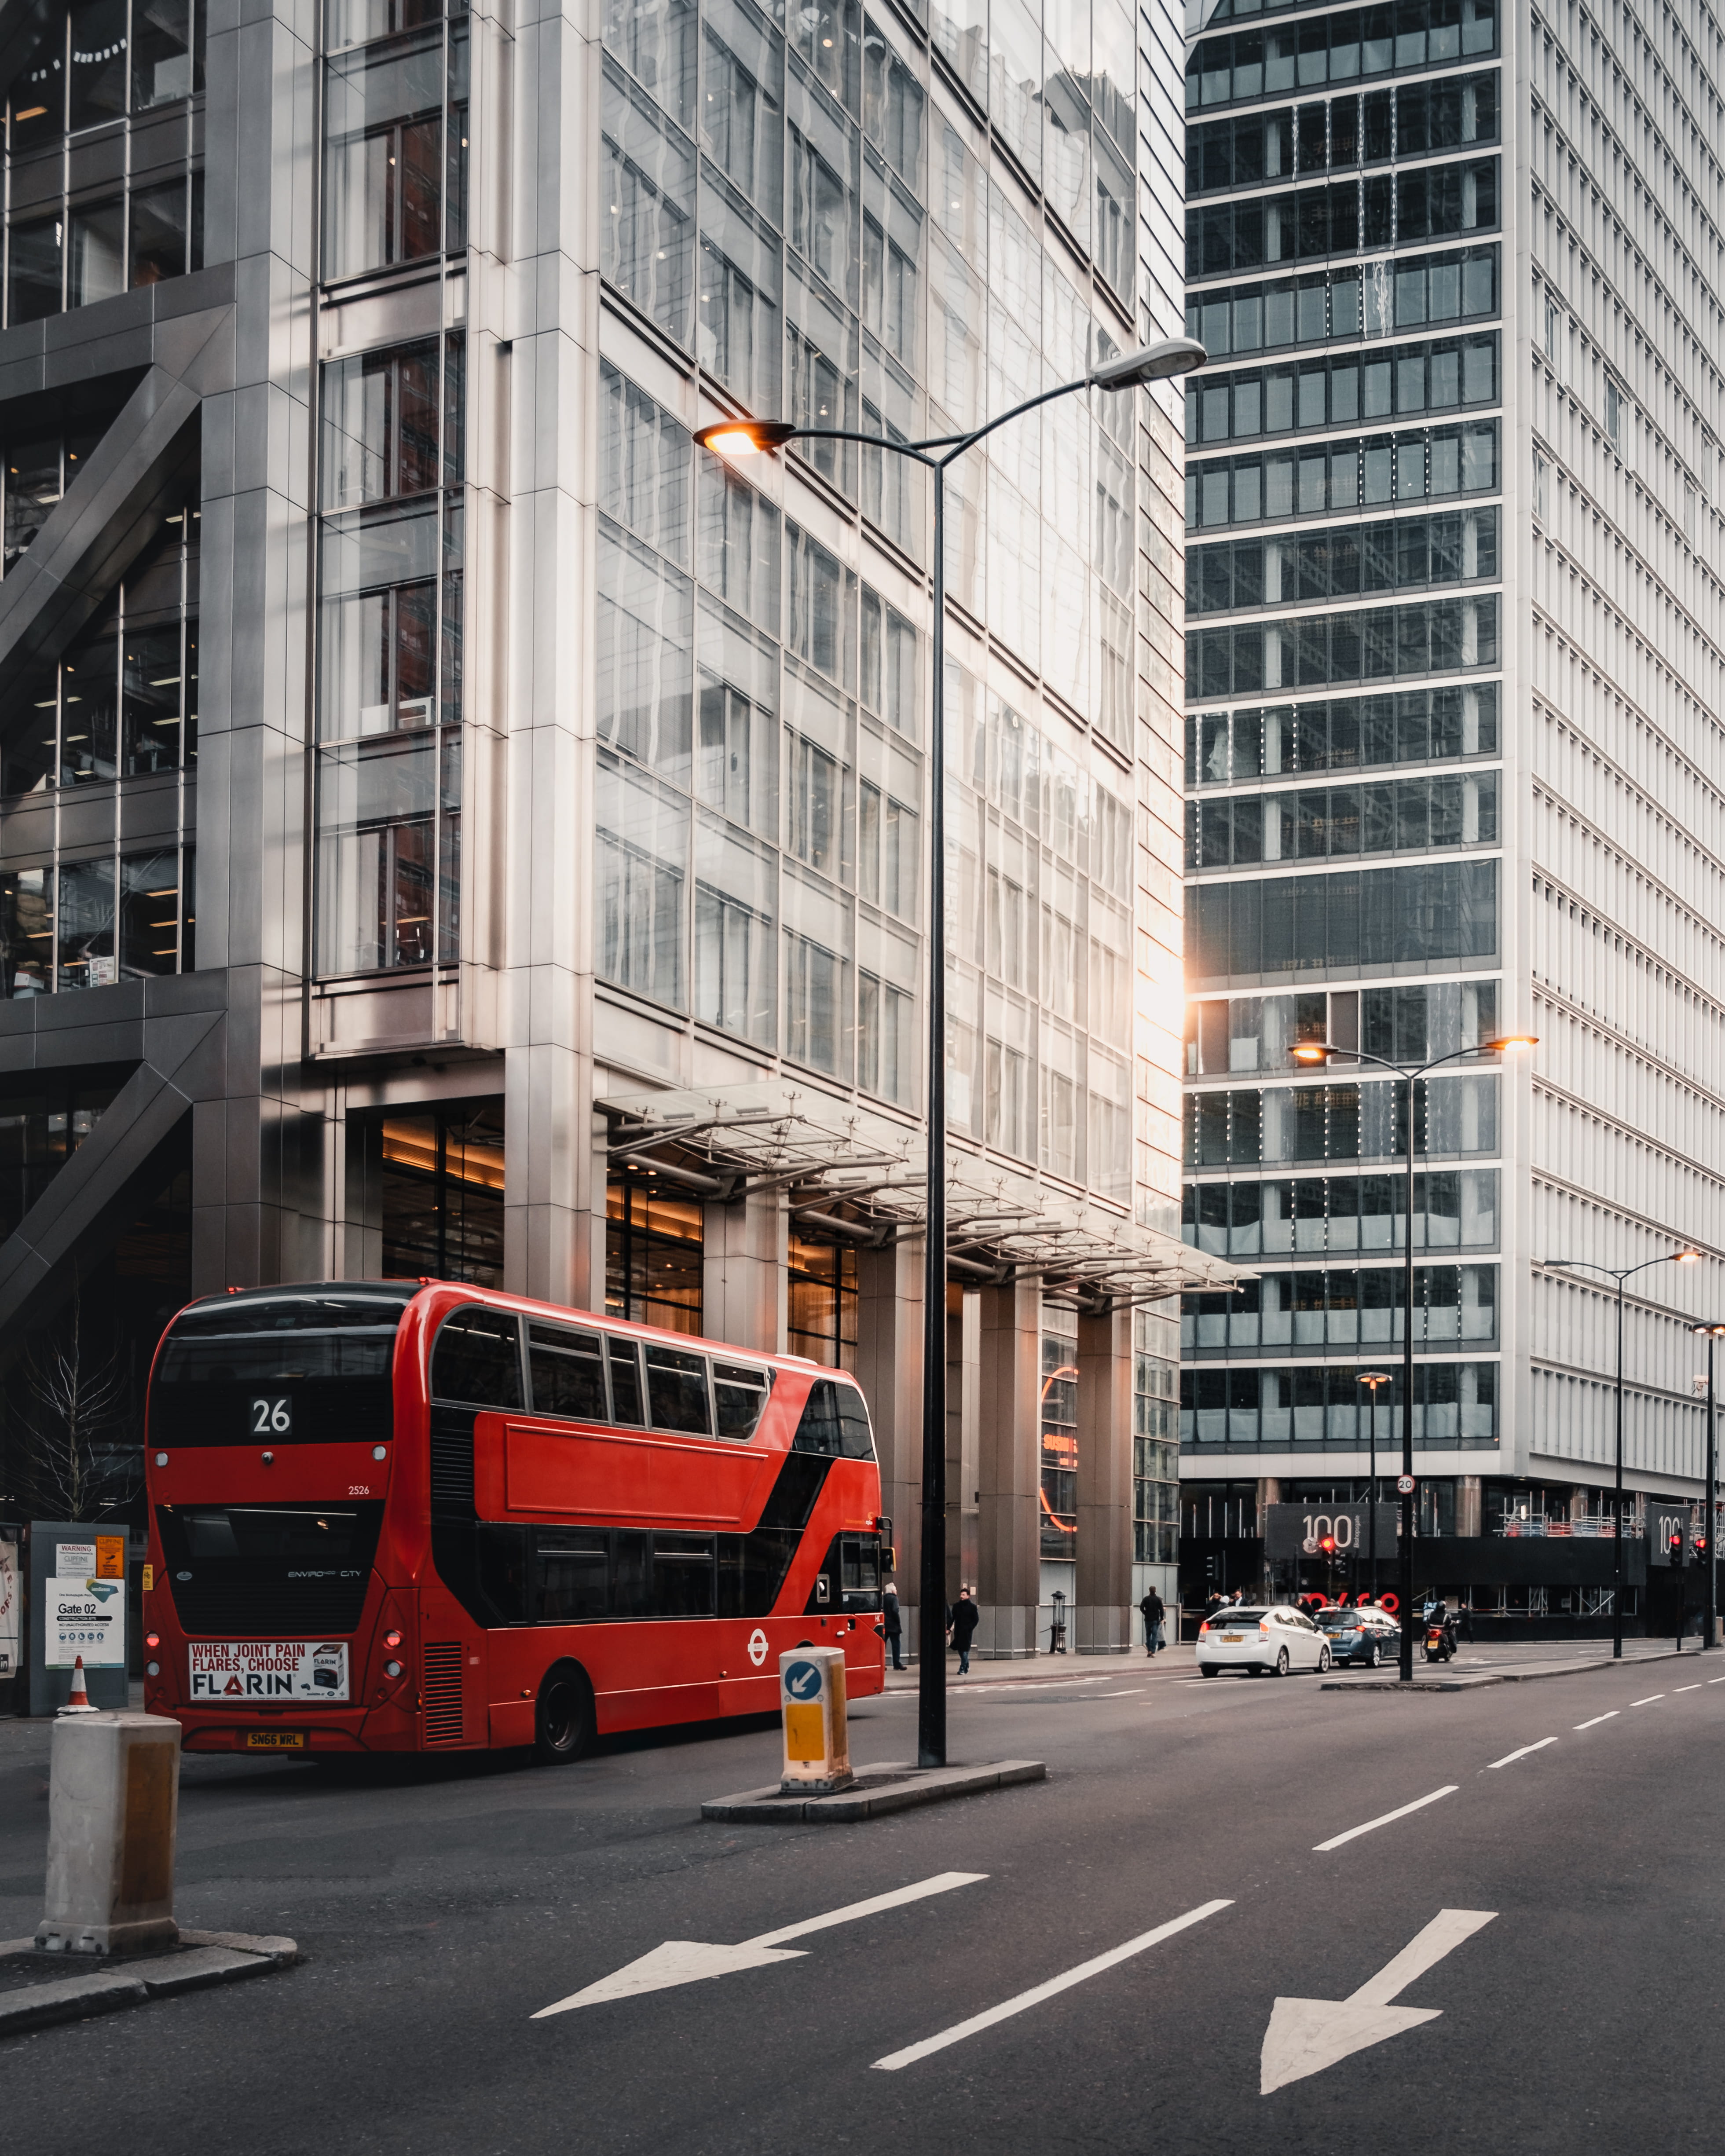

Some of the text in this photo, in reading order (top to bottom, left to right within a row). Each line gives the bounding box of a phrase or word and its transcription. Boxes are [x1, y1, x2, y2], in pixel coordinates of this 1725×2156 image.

[253, 1399, 290, 1431] 26
[348, 1486, 369, 1494] 2526
[1303, 1515, 1351, 1548] 100
[58, 1603, 96, 1614] Gate 02
[192, 1644, 305, 1658] WHEN JOINT PAIN
[193, 1658, 299, 1674] FLARES, CHOOSE
[251, 1734, 299, 1745] SN66 WRL
